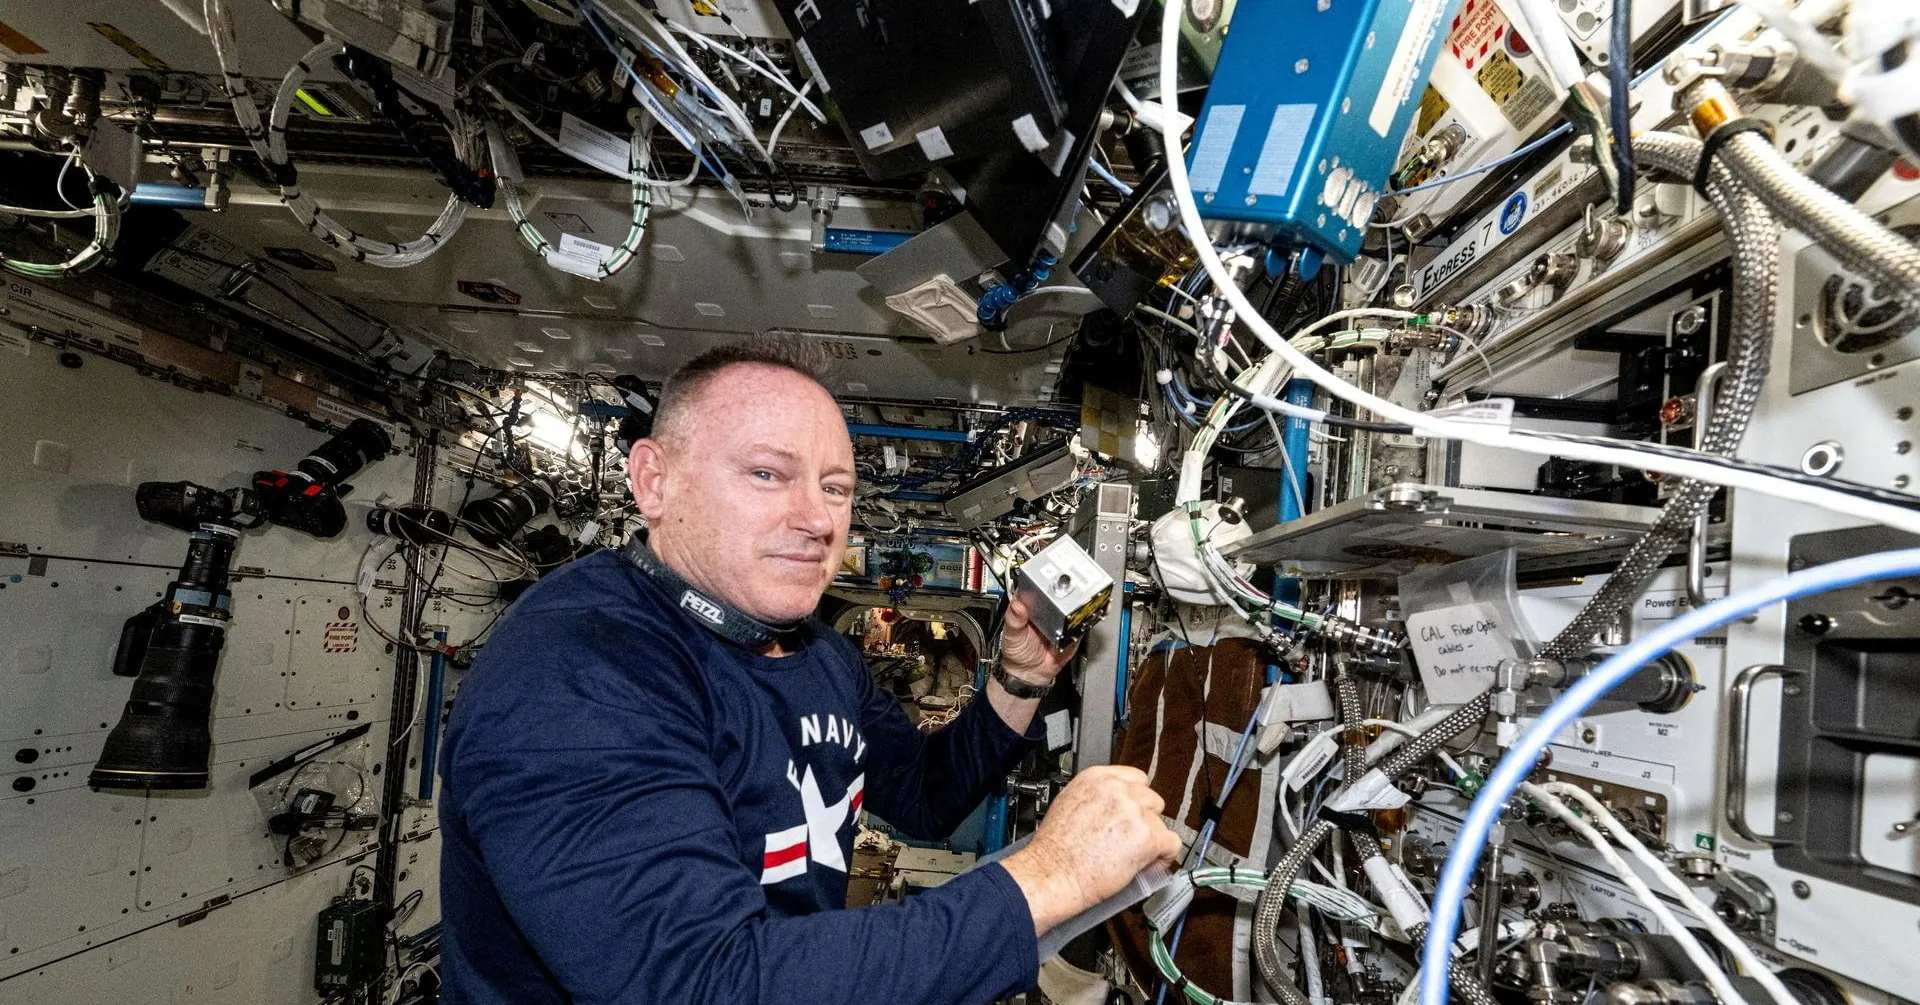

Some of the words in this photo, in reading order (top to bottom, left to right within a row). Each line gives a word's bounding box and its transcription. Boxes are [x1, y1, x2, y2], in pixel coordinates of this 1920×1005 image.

[1453, 11, 1481, 43] EMERGENCY
[1459, 29, 1477, 51] FIRE
[1475, 5, 1498, 32] PORT
[1481, 59, 1502, 82] CAUTION
[1422, 240, 1477, 293] EXPRESS
[1482, 220, 1494, 248] 7
[10, 283, 33, 298] CIR
[680, 591, 724, 624] PETZL
[1645, 598, 1676, 608] Power
[1421, 626, 1445, 642] CAL
[1451, 624, 1473, 636] Fiber
[1434, 665, 1446, 677] Do
[1451, 664, 1466, 674] not
[800, 713, 867, 765] NAVY
[1591, 760, 1600, 768] J2
[1641, 771, 1651, 779] J3
[1590, 883, 1616, 898] LAPTOP
[1789, 938, 1818, 955] Open
